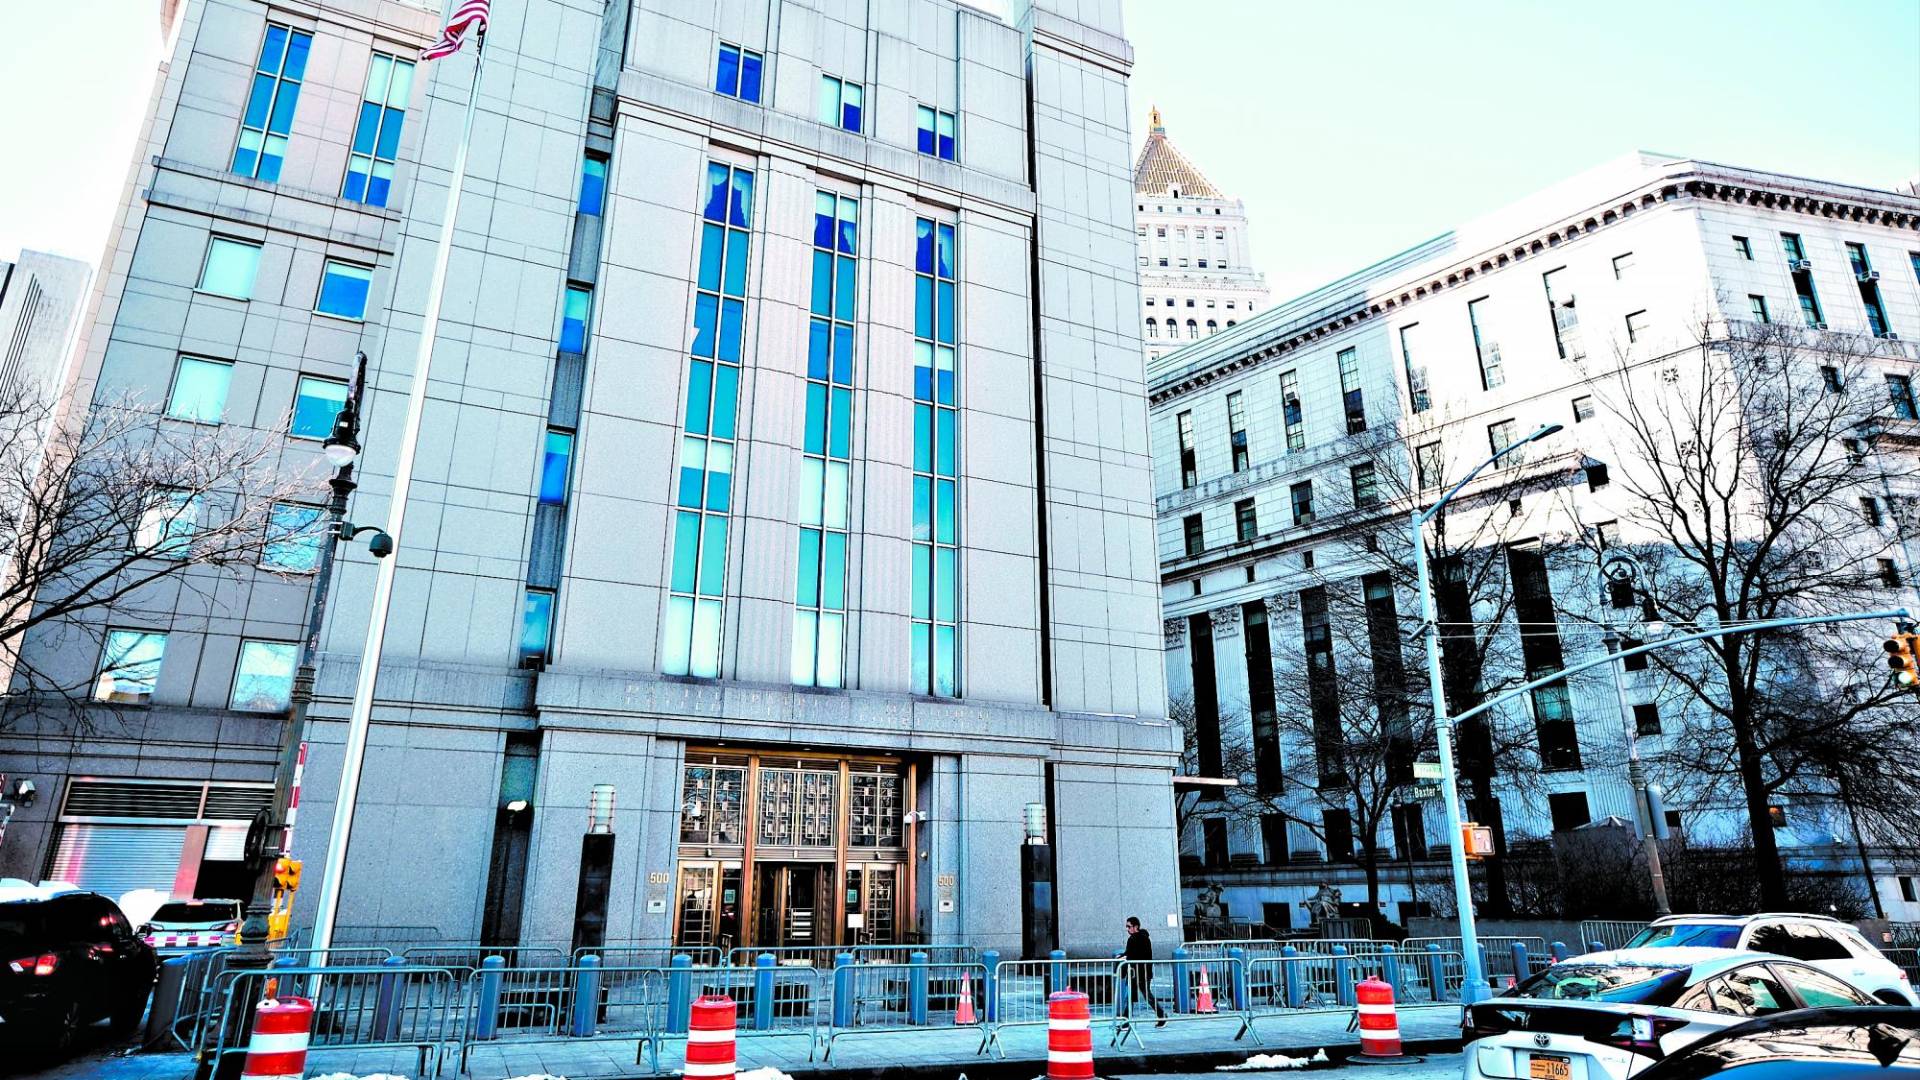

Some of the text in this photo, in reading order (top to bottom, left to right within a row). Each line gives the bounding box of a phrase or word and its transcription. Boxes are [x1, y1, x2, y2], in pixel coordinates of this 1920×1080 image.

[1414, 786, 1436, 798] Baxter
[650, 872, 670, 884] 500
[939, 875, 954, 886] 500
